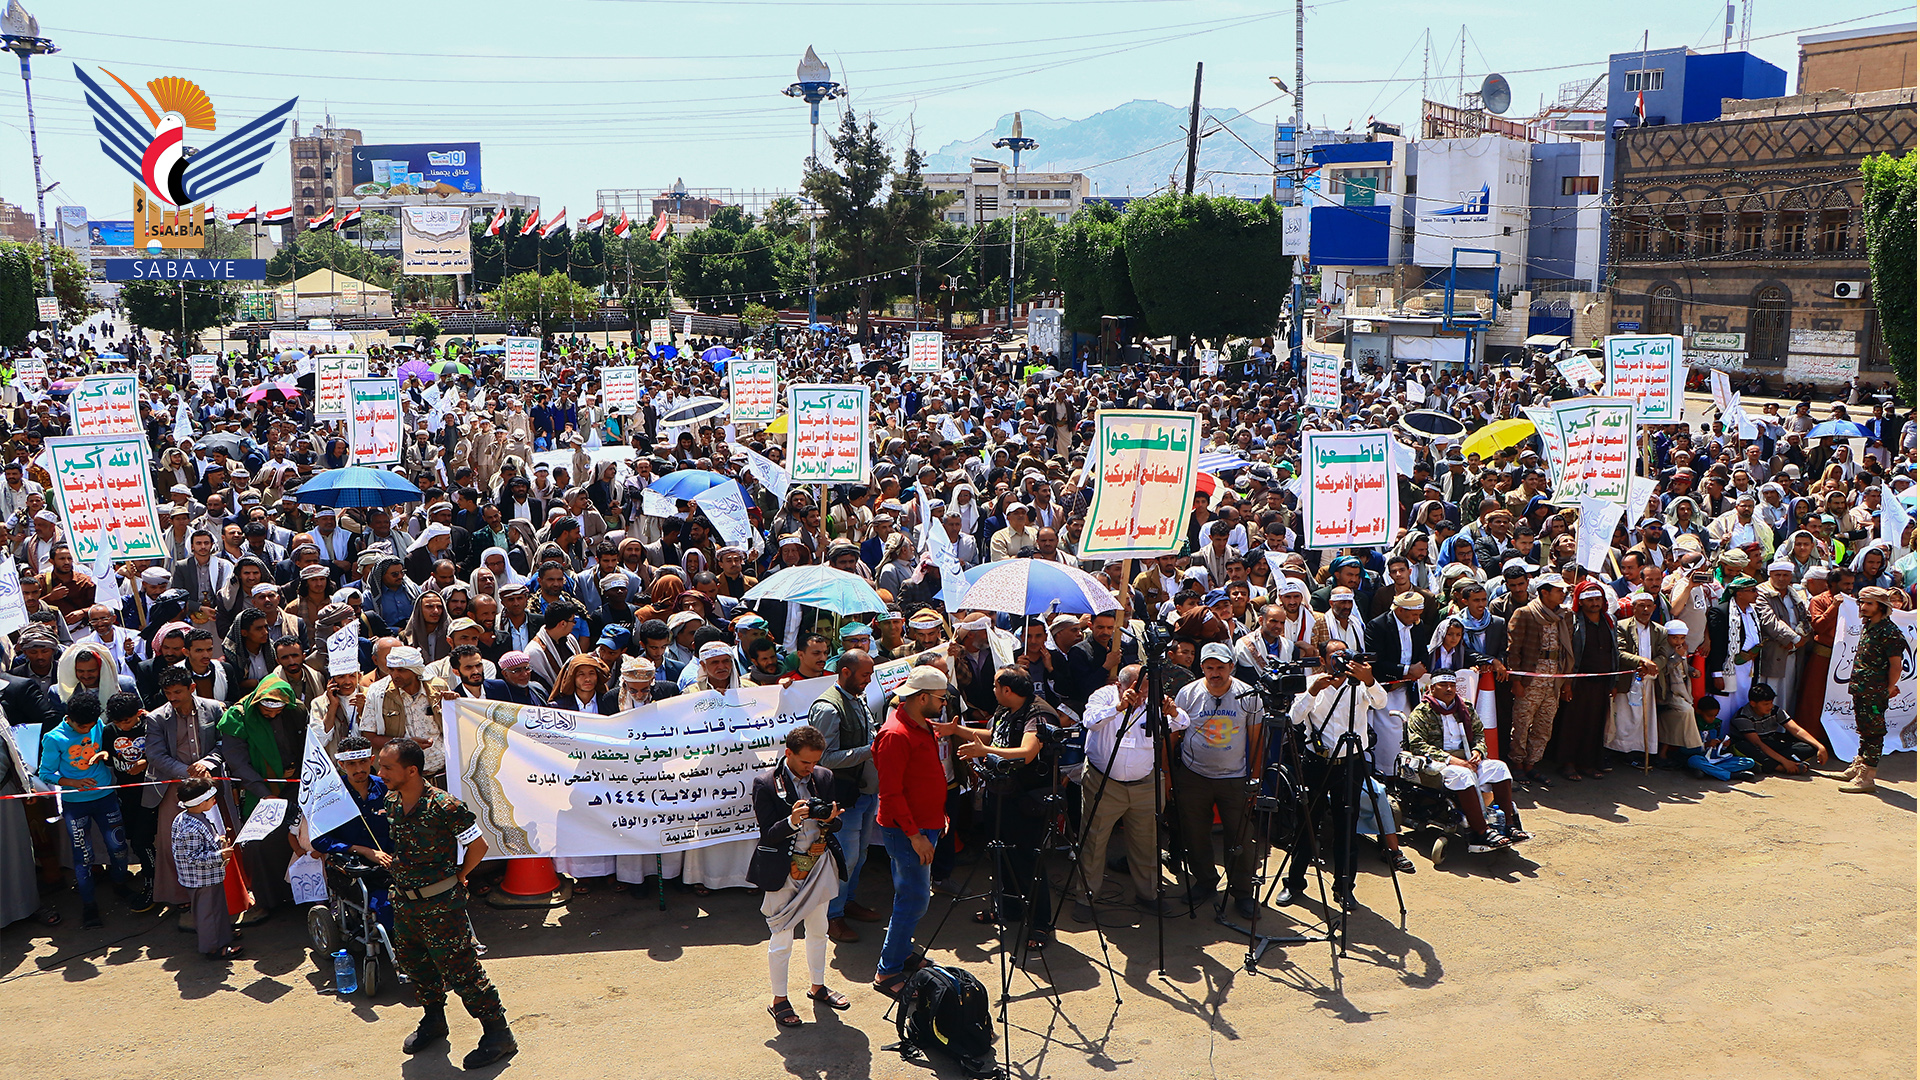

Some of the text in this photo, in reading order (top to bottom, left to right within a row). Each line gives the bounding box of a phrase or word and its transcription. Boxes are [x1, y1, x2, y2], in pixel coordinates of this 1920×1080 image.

[1614, 340, 1670, 359] الله أكبر
[346, 360, 362, 370] الله
[758, 365, 773, 374] الله
[1645, 360, 1669, 371] الموت
[1645, 374, 1669, 385] الموت
[77, 380, 132, 402] الله أكبر
[798, 392, 859, 413] الله أكبر
[1643, 400, 1668, 415] النصر
[832, 416, 859, 427] الموت
[1565, 408, 1629, 434] الله أكبر
[832, 432, 859, 443] الموت
[1596, 434, 1627, 446] الموت
[821, 447, 835, 458] على
[838, 446, 858, 457] اللعنة
[1595, 451, 1626, 463] الموت
[60, 445, 139, 476] الله أكبر
[829, 460, 858, 477] النصر
[1140, 463, 1183, 487] البضائع
[1582, 467, 1598, 479] على
[1601, 467, 1625, 478] اللعنة
[107, 474, 141, 491] الموت
[1354, 473, 1385, 492] البضائع
[1593, 482, 1624, 498] النصر
[111, 495, 145, 511] الموت
[1130, 490, 1136, 508] و
[1347, 497, 1352, 512] و
[105, 517, 121, 532] على
[124, 515, 150, 527] اللعنة
[124, 532, 156, 554] النصر
[1199, 709, 1237, 718] CALIFORNIA
[628, 725, 679, 740] الثورة
[683, 718, 725, 736] قائد
[748, 735, 775, 749] الملك
[568, 748, 587, 760] الله
[591, 749, 630, 763] يحفظه
[634, 745, 678, 765] الحوثي
[609, 771, 628, 783] عيد
[632, 770, 675, 785] بمناسبتي
[679, 767, 713, 782] العظيم
[717, 762, 748, 778] اليمني
[527, 772, 560, 786] المبارك
[611, 816, 648, 830] والوفاء
[652, 813, 684, 826] بالولاء
[688, 811, 713, 822] العهد
[665, 822, 760, 845] ديرية صنعاء القديمة
